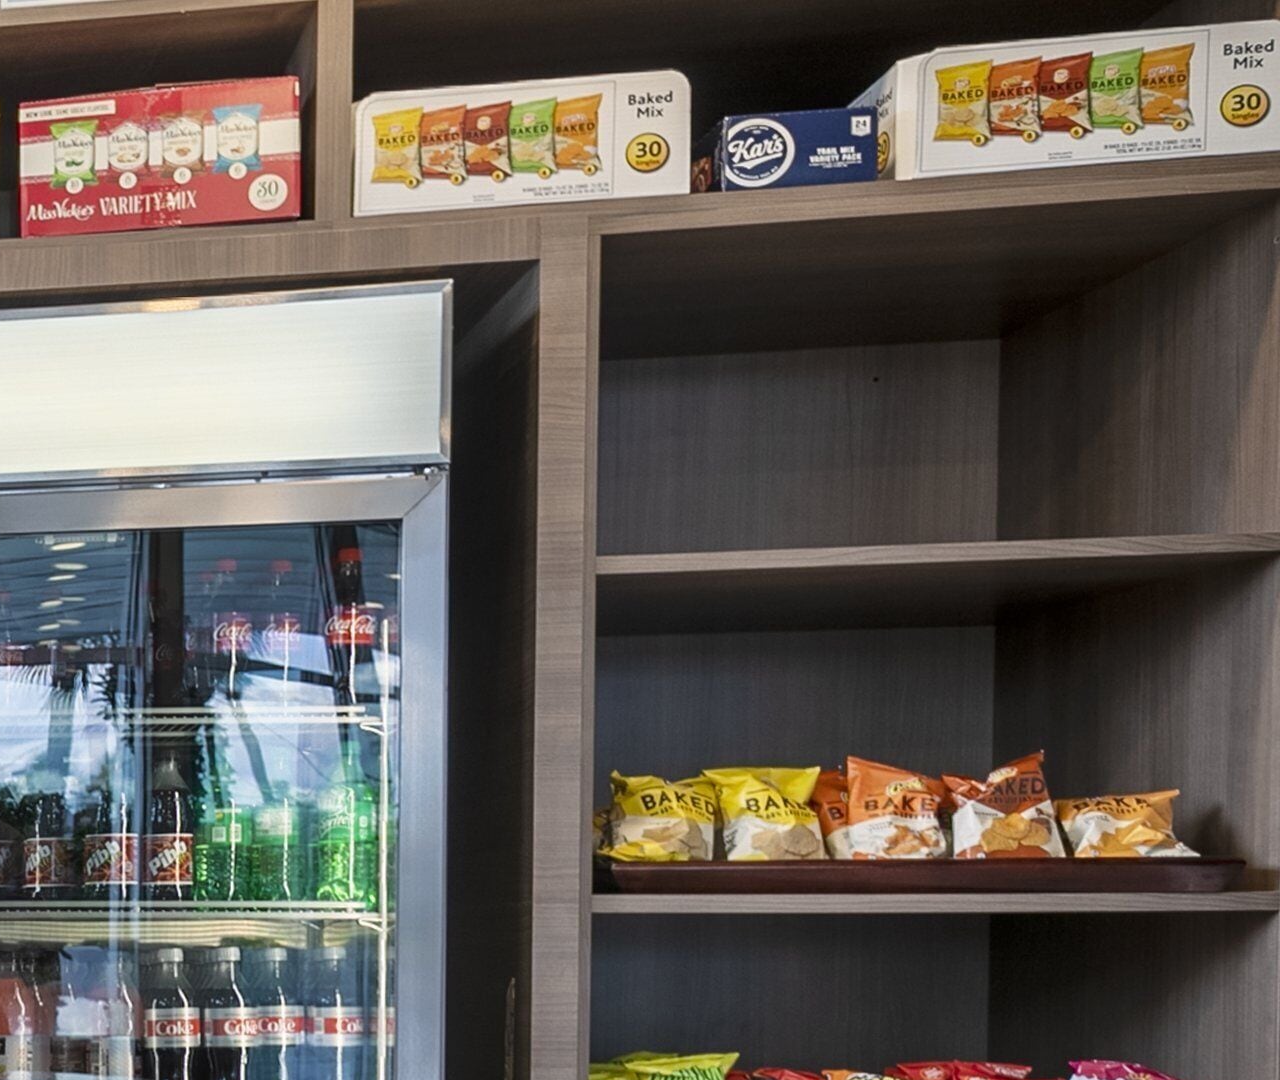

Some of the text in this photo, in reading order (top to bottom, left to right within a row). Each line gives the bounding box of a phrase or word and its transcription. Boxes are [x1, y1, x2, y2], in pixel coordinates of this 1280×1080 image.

[1223, 39, 1275, 56] Baked
[1233, 56, 1264, 70] Mix
[1041, 81, 1083, 93] BAKED
[1091, 76, 1134, 89] BAKED
[1142, 75, 1187, 86] BAKED
[627, 91, 674, 106] Baked
[942, 89, 984, 101] BAKED
[991, 86, 1034, 98] BAKED
[1231, 93, 1261, 112] 30
[637, 106, 664, 119] Mix
[510, 124, 549, 136] BAKED
[555, 121, 595, 133] BAKED
[855, 119, 867, 129] 24
[378, 134, 416, 146] BAKED
[635, 141, 662, 159] 30
[727, 133, 784, 164] Kar's
[816, 145, 856, 155] TRAIL MIX
[809, 152, 862, 164] VARIETY PACK
[257, 180, 279, 197] 30
[99, 193, 163, 216] VARIETY
[165, 190, 197, 210] MIX
[641, 790, 715, 816] BAKED
[864, 794, 937, 812] BAKE
[86, 840, 121, 875] Pibb
[148, 839, 188, 877] Pibb
[155, 1020, 194, 1036] Coke
[257, 1018, 296, 1034] Coke
